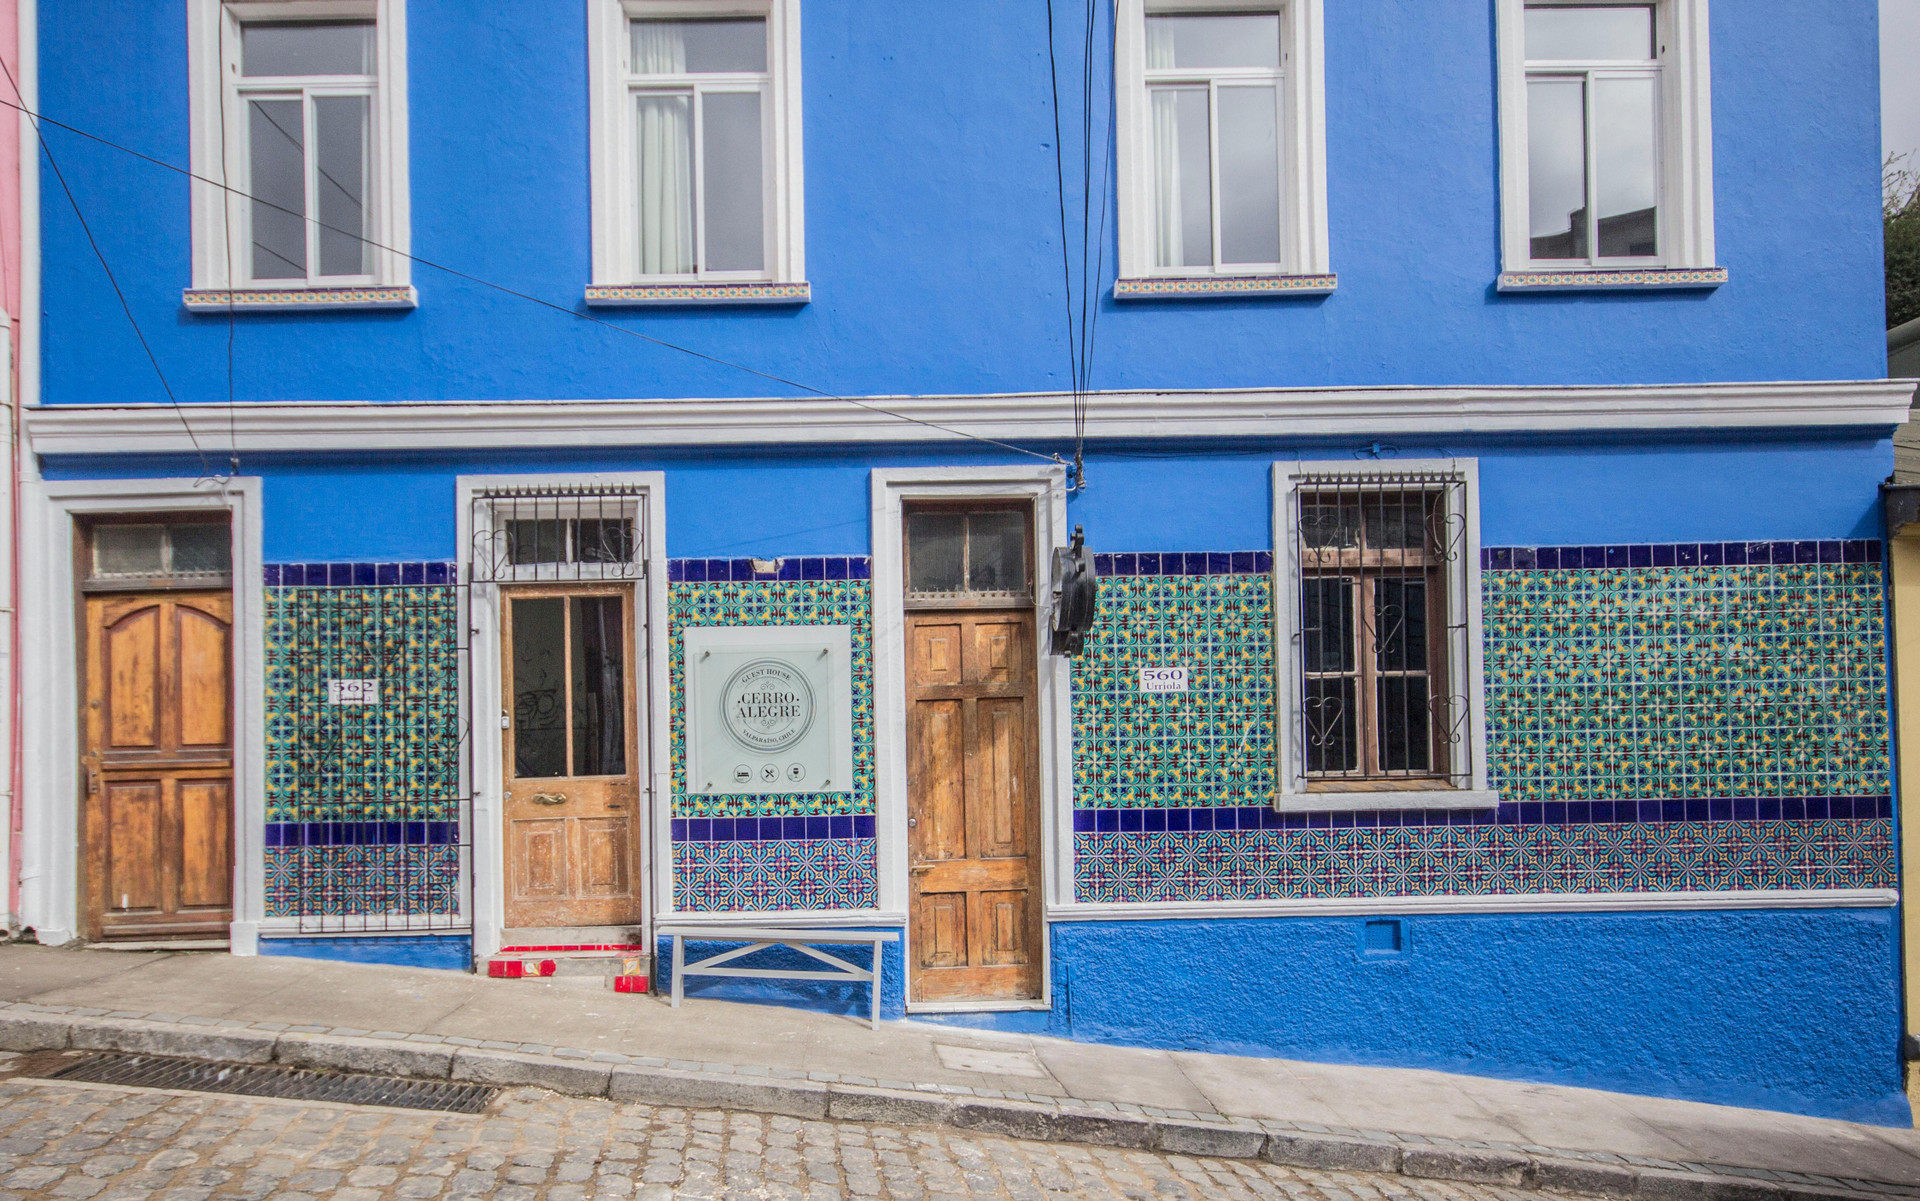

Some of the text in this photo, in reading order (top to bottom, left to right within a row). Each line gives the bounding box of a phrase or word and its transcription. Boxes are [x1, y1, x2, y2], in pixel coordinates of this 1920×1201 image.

[742, 668, 791, 683] GUEST HOUSE
[1143, 670, 1183, 681] 560
[332, 681, 374, 692] 562
[1146, 681, 1181, 690] Urriola
[738, 705, 801, 718] ALEGRE
[779, 729, 795, 740] CHILE
